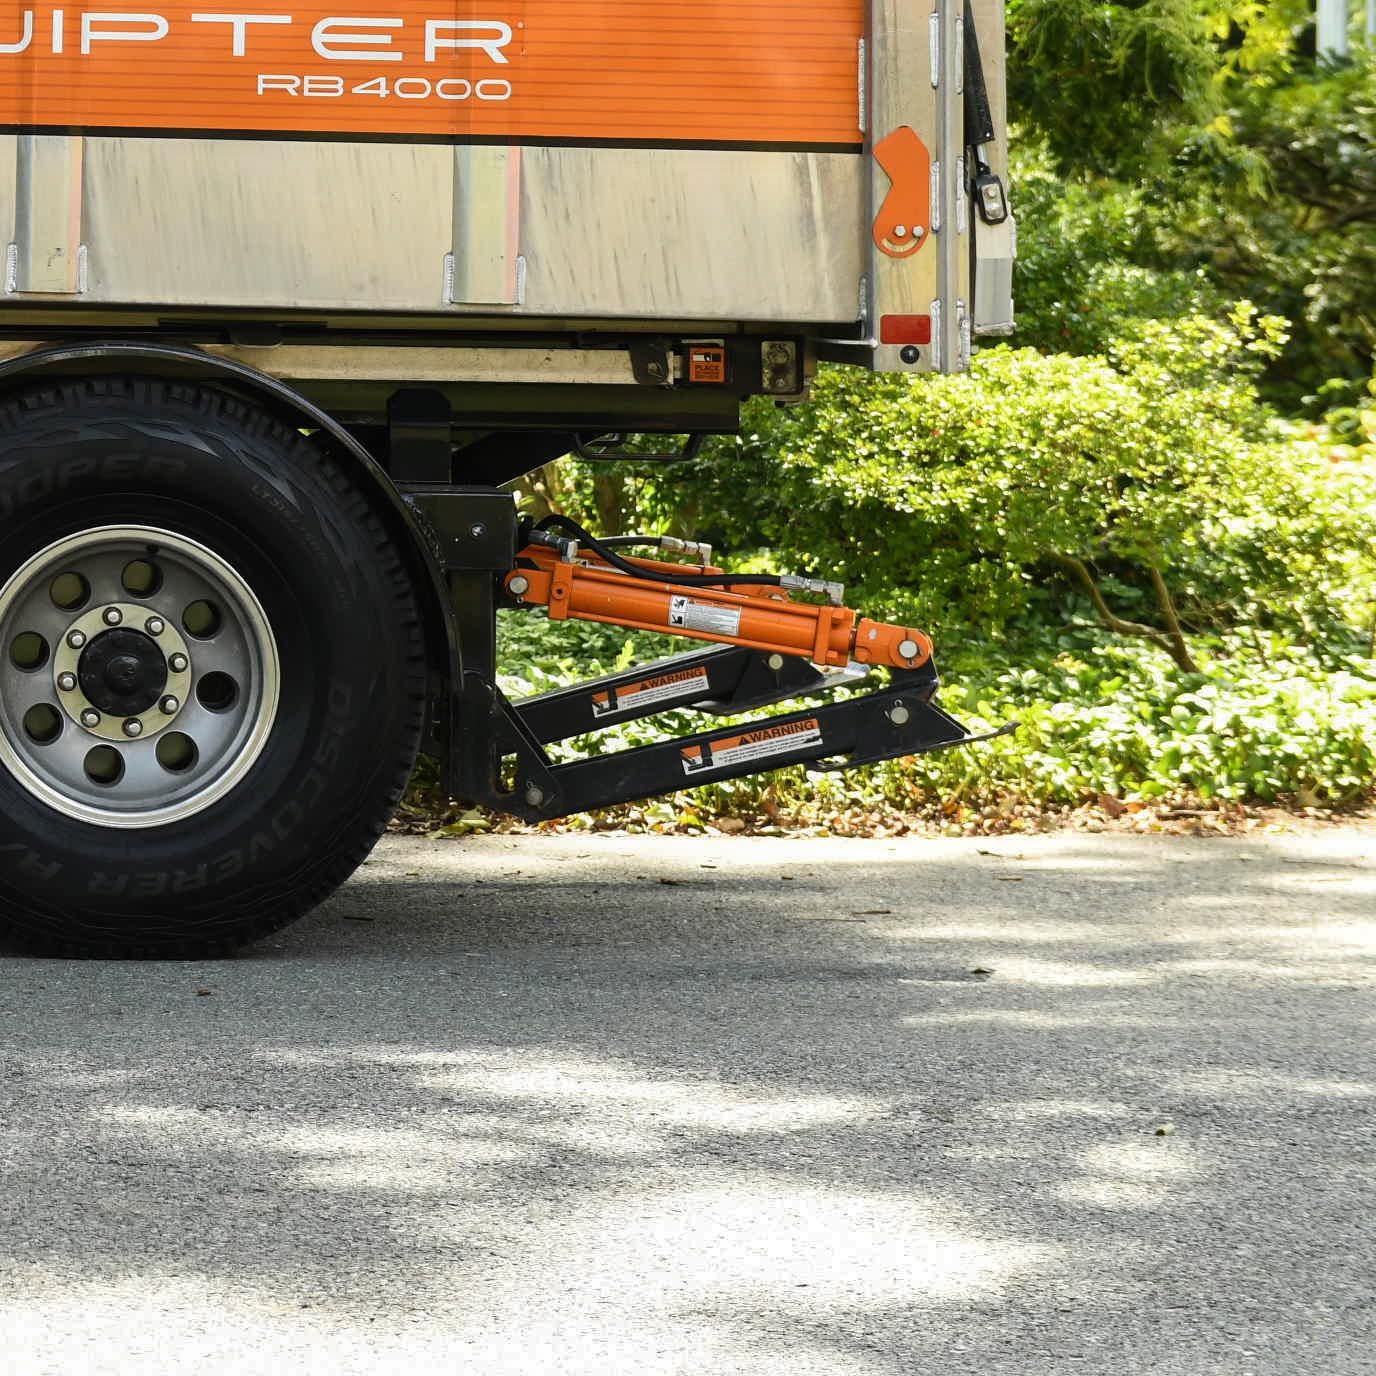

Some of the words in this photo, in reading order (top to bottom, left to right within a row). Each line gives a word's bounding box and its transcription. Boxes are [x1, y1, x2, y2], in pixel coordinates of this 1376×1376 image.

[256, 73, 512, 101] RB4000
[648, 668, 703, 688] WARNING
[749, 721, 814, 744] WARNING
